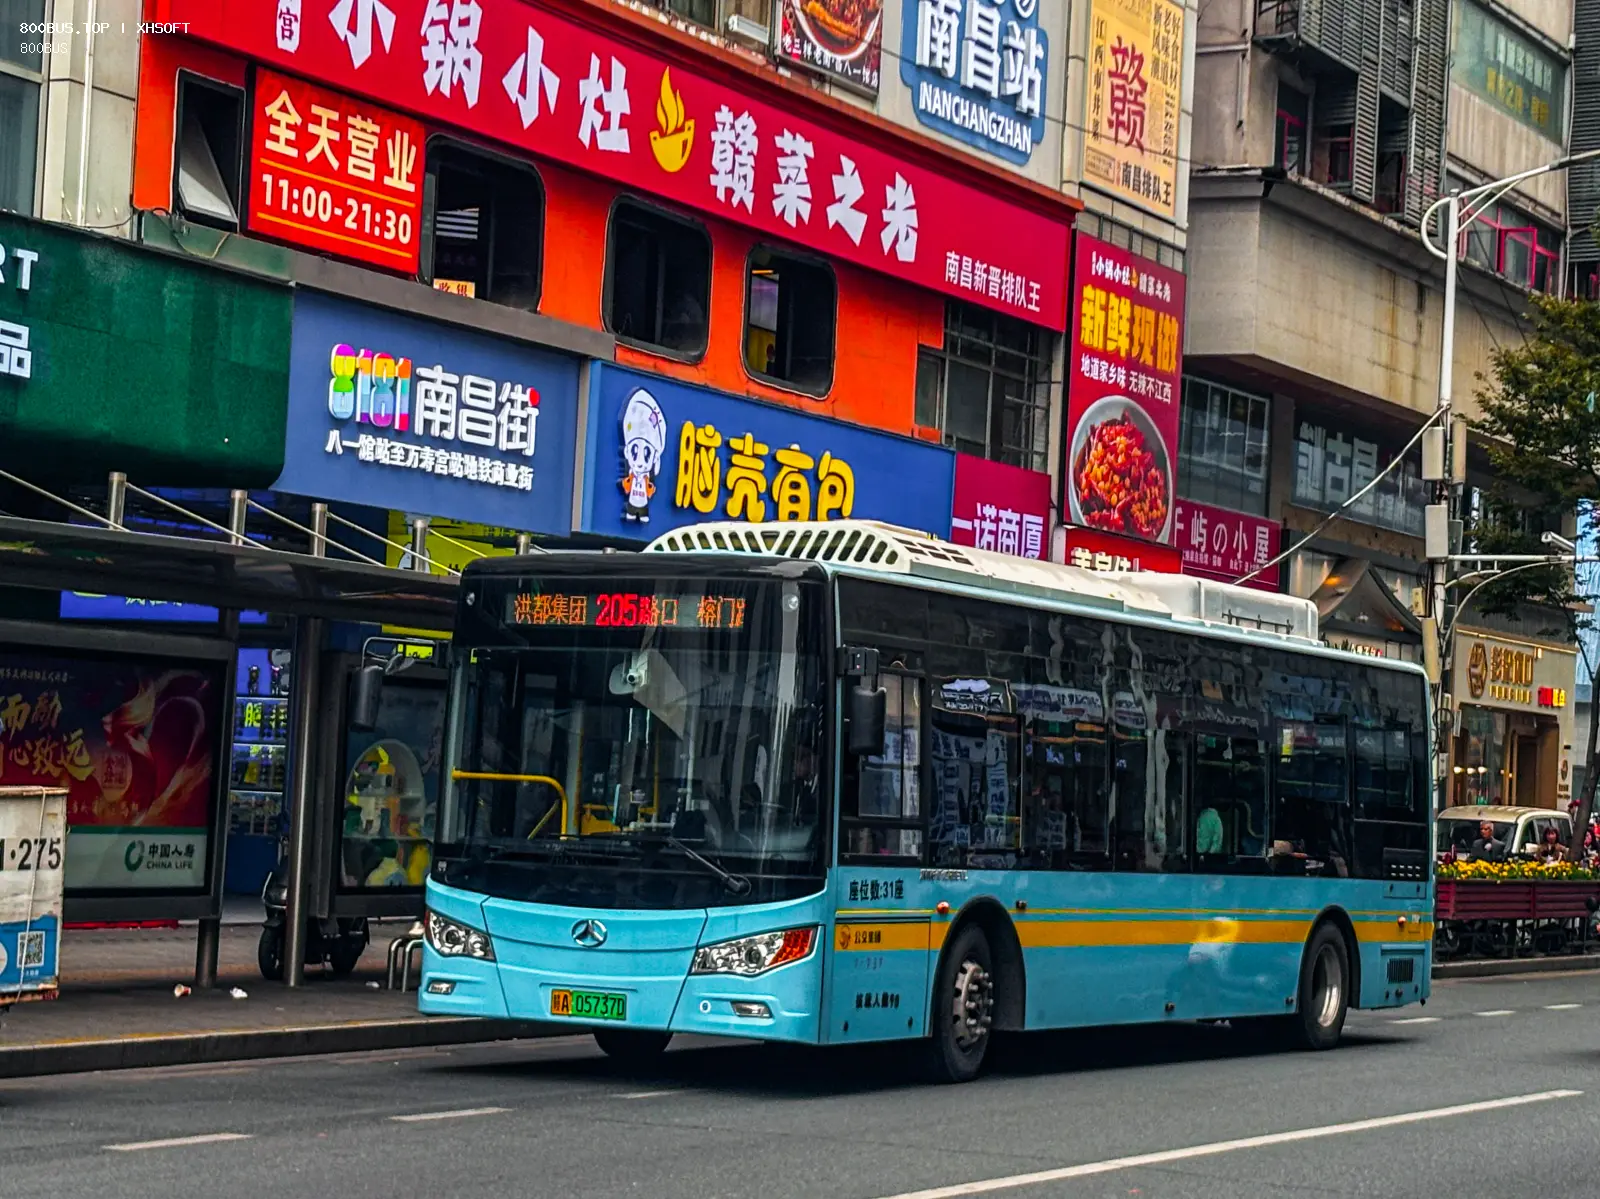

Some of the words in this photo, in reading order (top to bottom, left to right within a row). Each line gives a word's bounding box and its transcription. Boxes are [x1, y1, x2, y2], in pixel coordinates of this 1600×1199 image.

[915, 0, 1045, 118] 南昌站
[1107, 34, 1149, 157] 赣
[264, 89, 417, 193] 全天营业
[328, 0, 631, 154] 小锅小灶
[708, 103, 919, 264] 赣菜之光
[919, 81, 1032, 155] NANCHANGZHAN
[262, 173, 412, 245] 11:00-21:30
[944, 250, 1041, 313] 南昌新晋排队王
[327, 342, 414, 432] 8181
[415, 364, 541, 457] 南昌街
[675, 418, 856, 523] 脑壳有包
[951, 502, 1044, 560] 一诺商厦
[514, 593, 587, 626] 洪都集团
[147, 861, 173, 870] CHINA
[175, 862, 193, 870] LIFE
